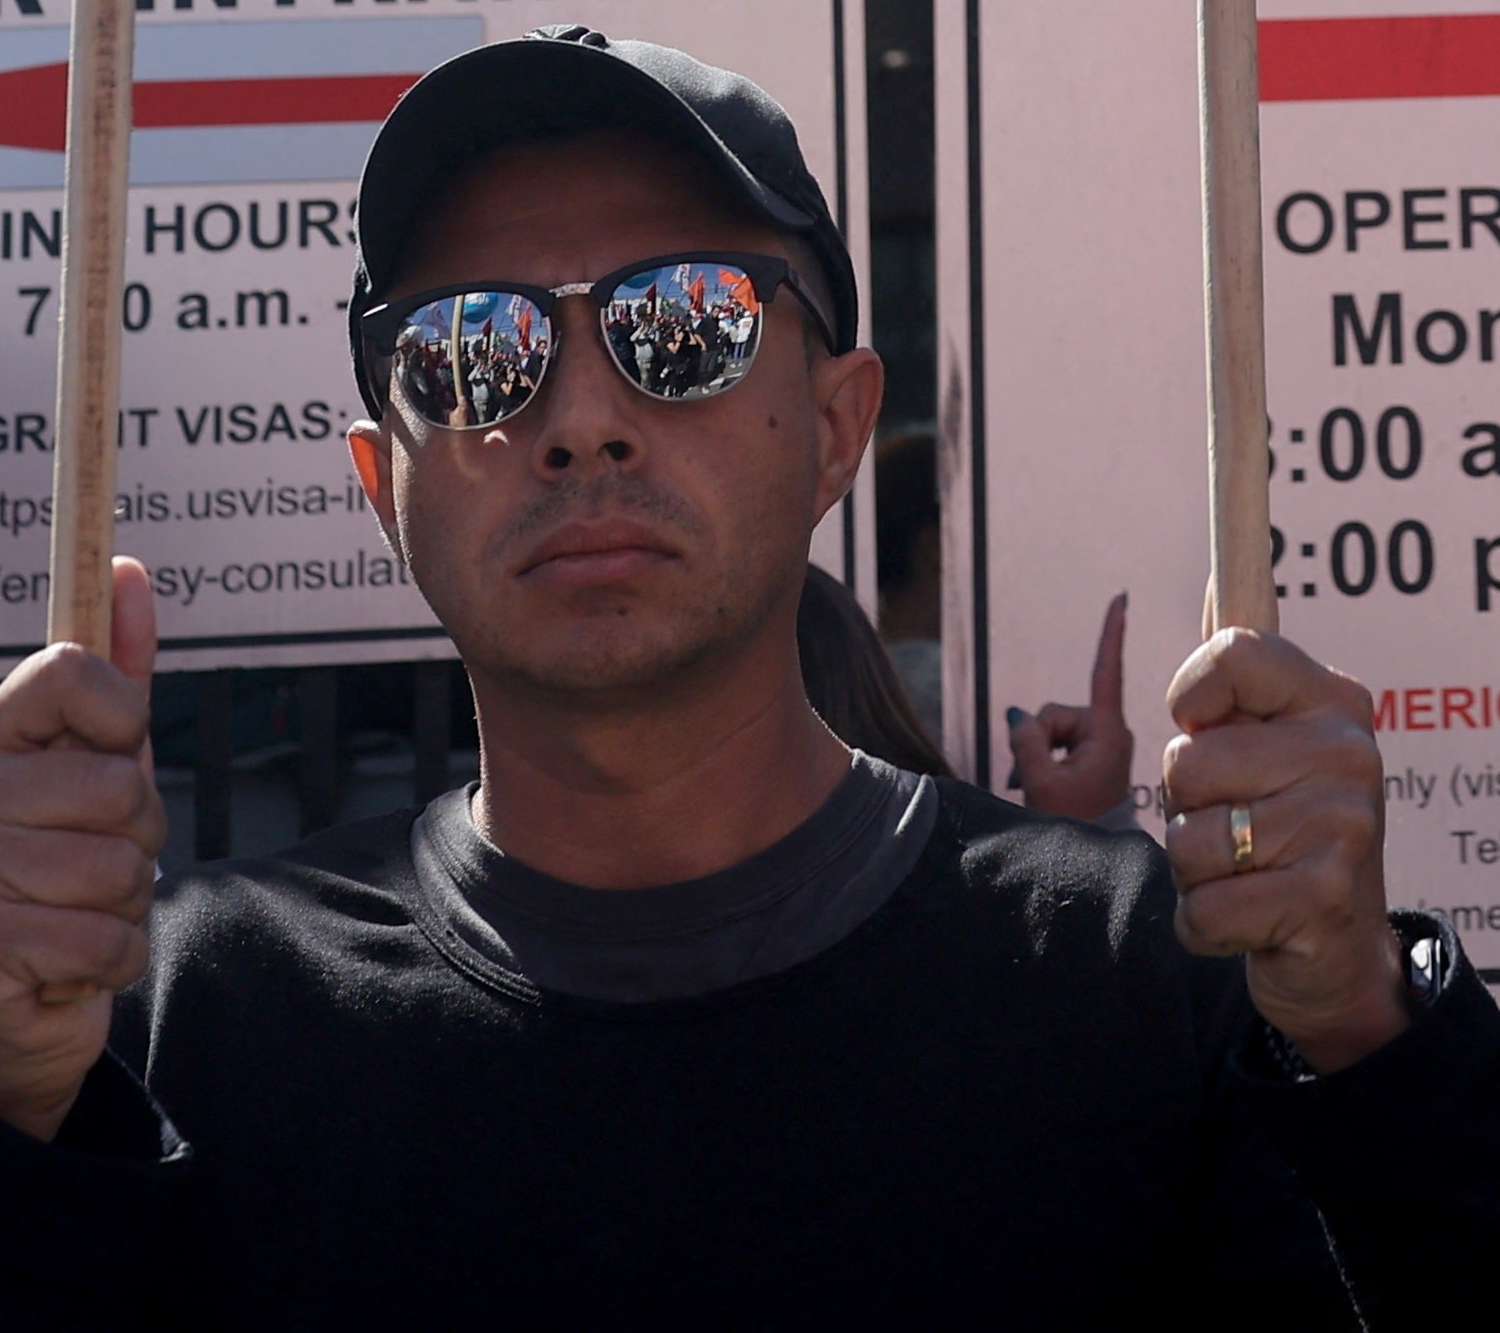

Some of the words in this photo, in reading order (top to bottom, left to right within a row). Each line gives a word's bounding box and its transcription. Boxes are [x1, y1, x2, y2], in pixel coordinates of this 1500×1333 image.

[145, 199, 358, 254] HOUR
[176, 288, 308, 330] a.m.
[176, 400, 347, 445] VISAS:
[1265, 405, 1423, 482] :00
[1384, 767, 1437, 809] nly
